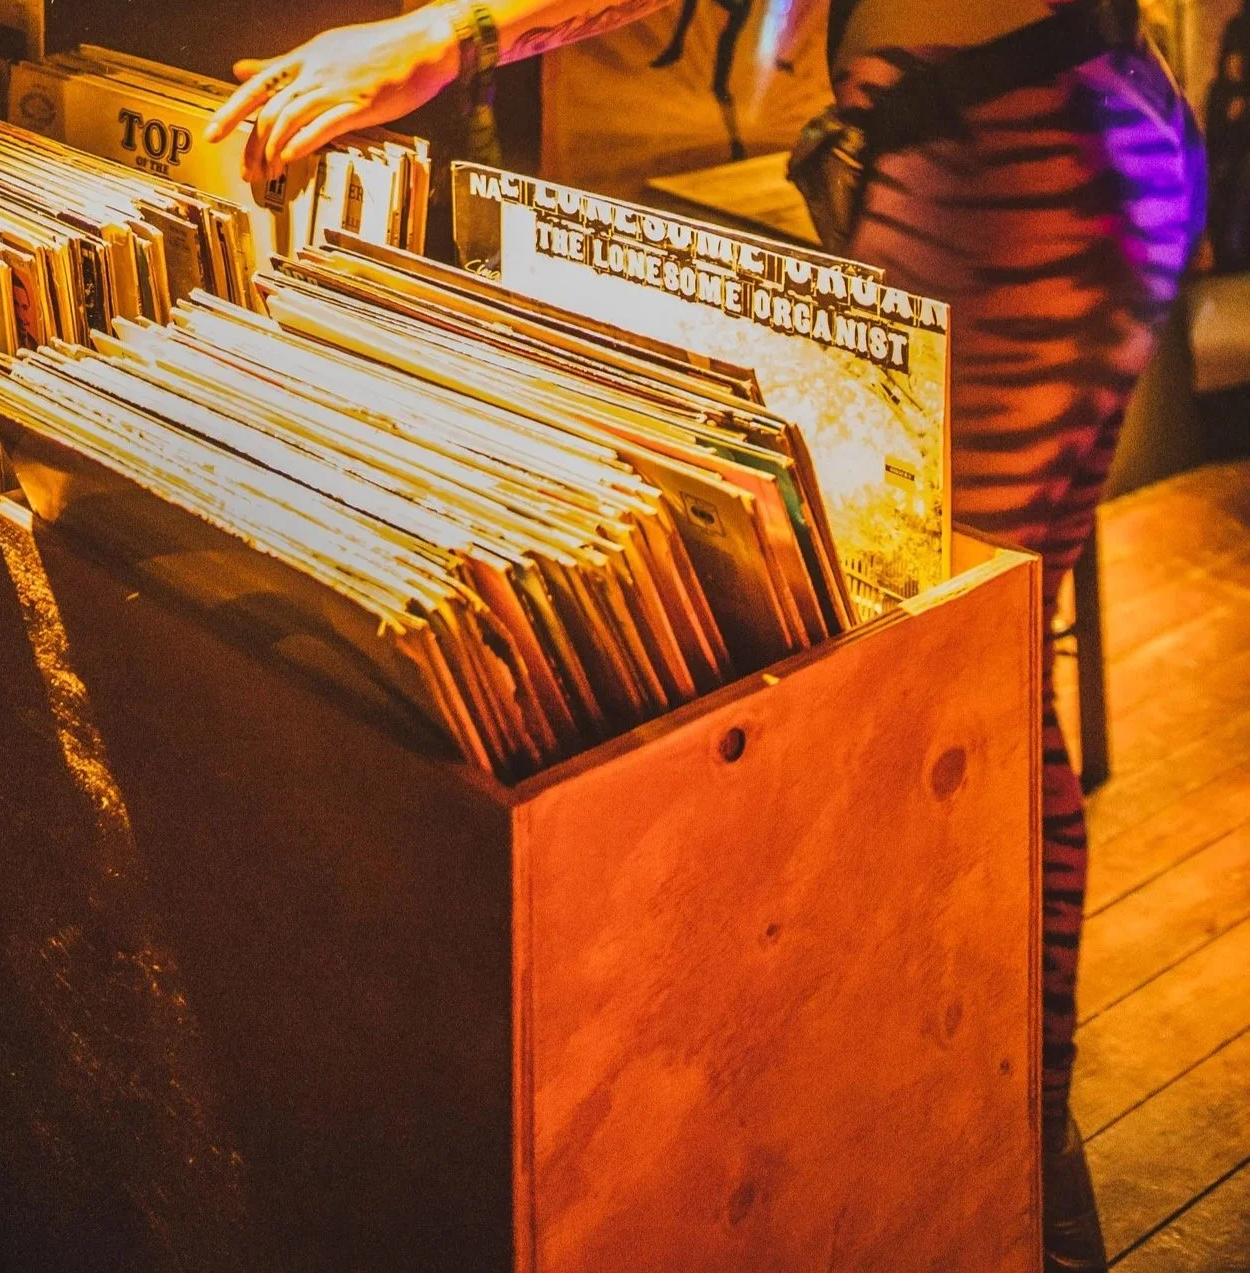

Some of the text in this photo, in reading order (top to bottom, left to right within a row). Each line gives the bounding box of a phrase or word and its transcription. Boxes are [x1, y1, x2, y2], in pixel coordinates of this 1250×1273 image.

[118, 107, 194, 167] TOP
[150, 160, 170, 175] THE
[536, 220, 909, 366] THE LONESOME ORGANIST
